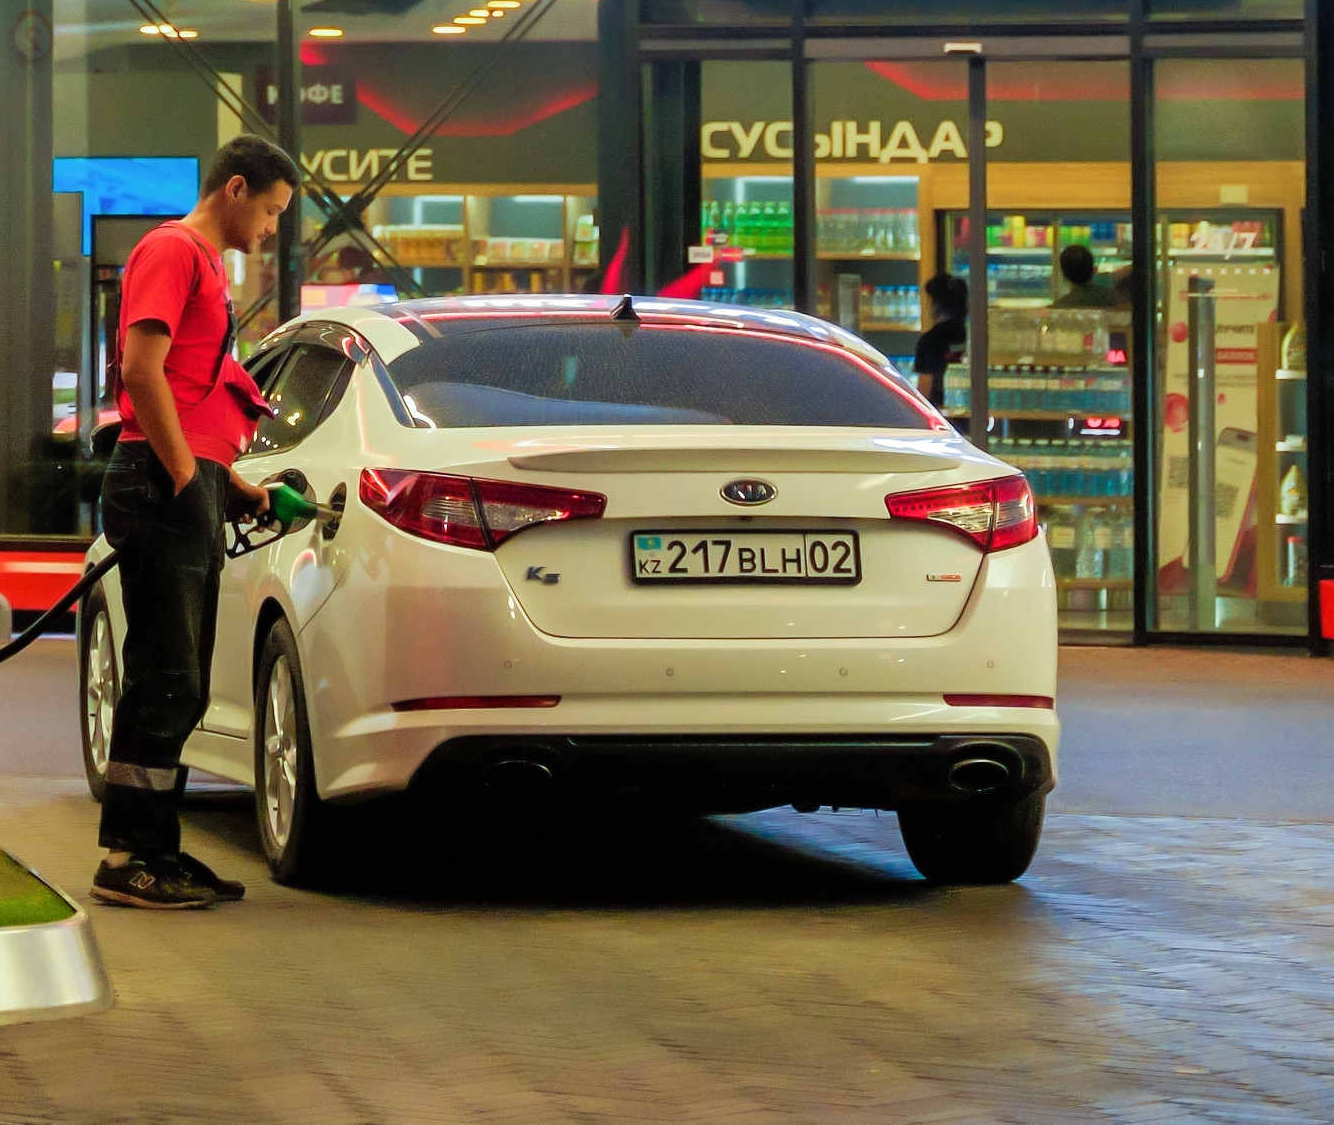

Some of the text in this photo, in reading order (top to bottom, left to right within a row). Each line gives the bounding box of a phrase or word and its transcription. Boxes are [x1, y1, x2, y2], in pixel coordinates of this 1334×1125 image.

[1190, 231, 1258, 261] 24/7
[638, 559, 662, 574] KZ
[667, 540, 852, 574] 217 BLH 02
